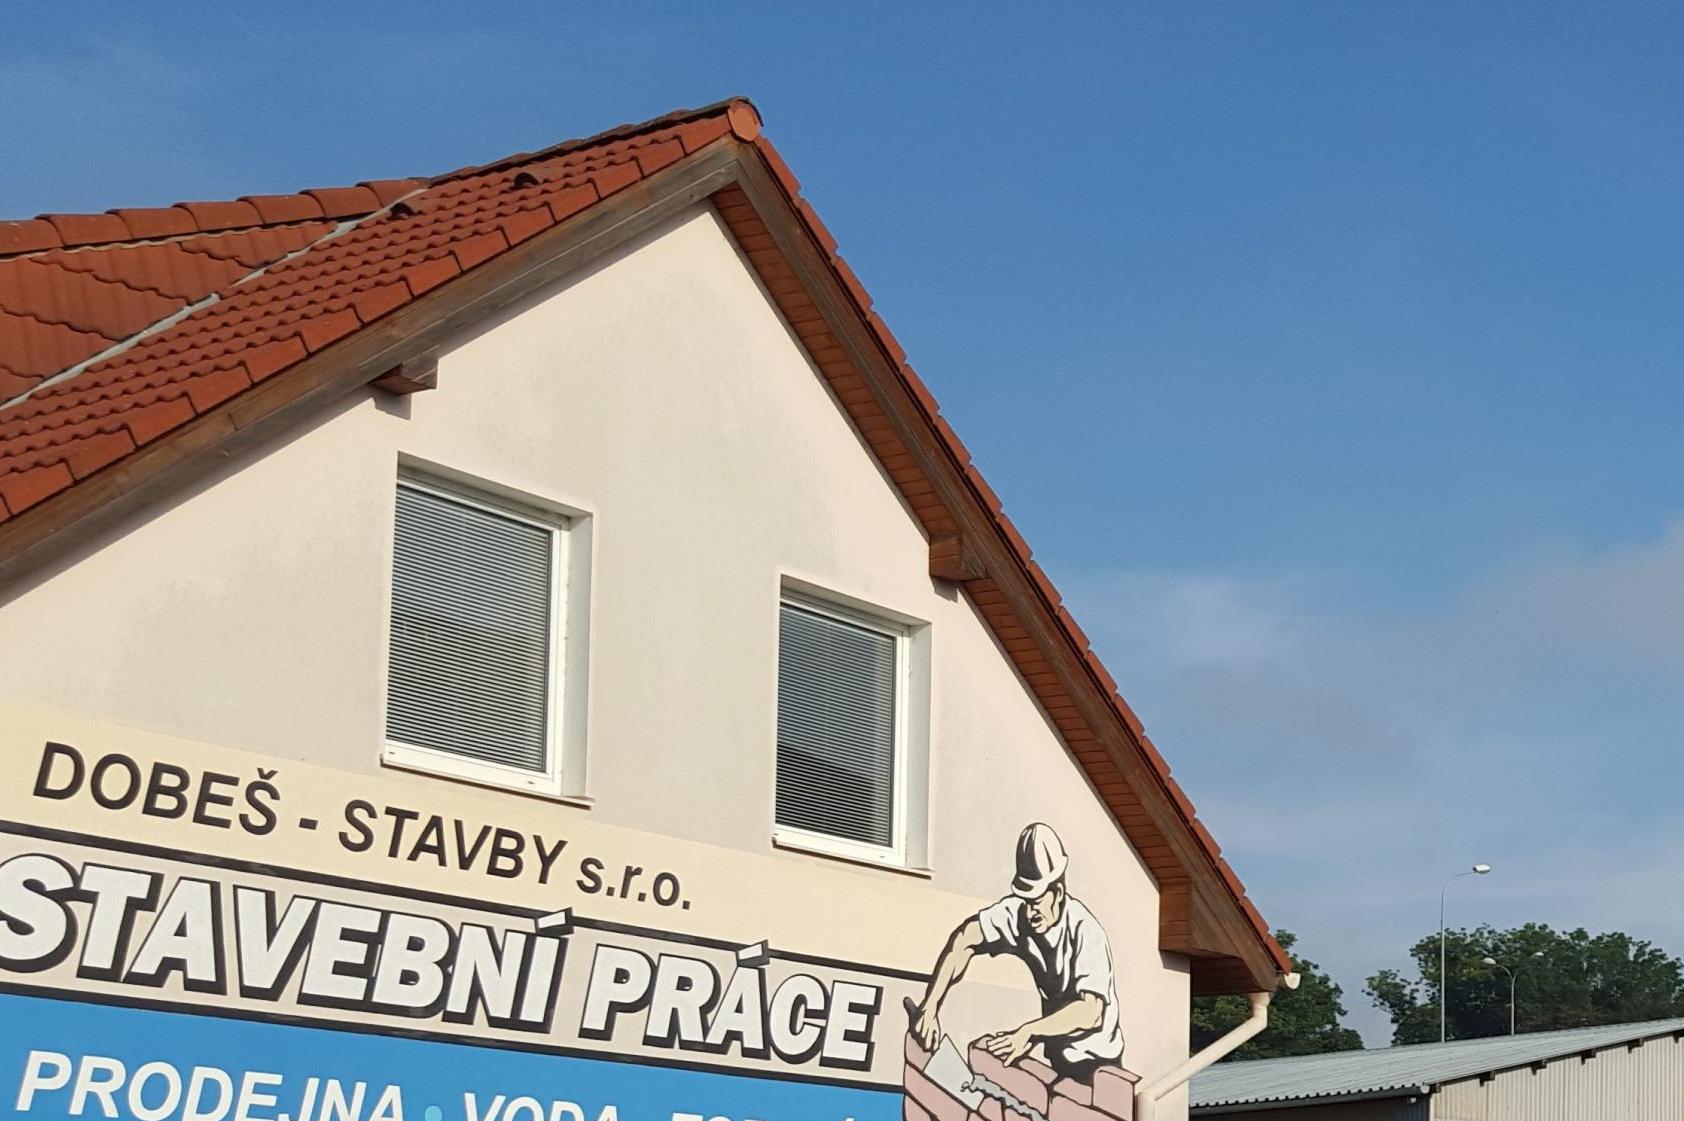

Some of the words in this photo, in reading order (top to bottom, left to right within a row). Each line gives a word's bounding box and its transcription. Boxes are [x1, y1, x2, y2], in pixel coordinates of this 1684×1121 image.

[33, 741, 281, 835] DOBEŠ
[299, 817, 317, 830] -
[338, 798, 567, 885] STAVBY
[576, 857, 691, 910] s.r.o.
[0, 852, 575, 1033] STAVEBNÍ
[580, 940, 883, 1072] PRÁCE
